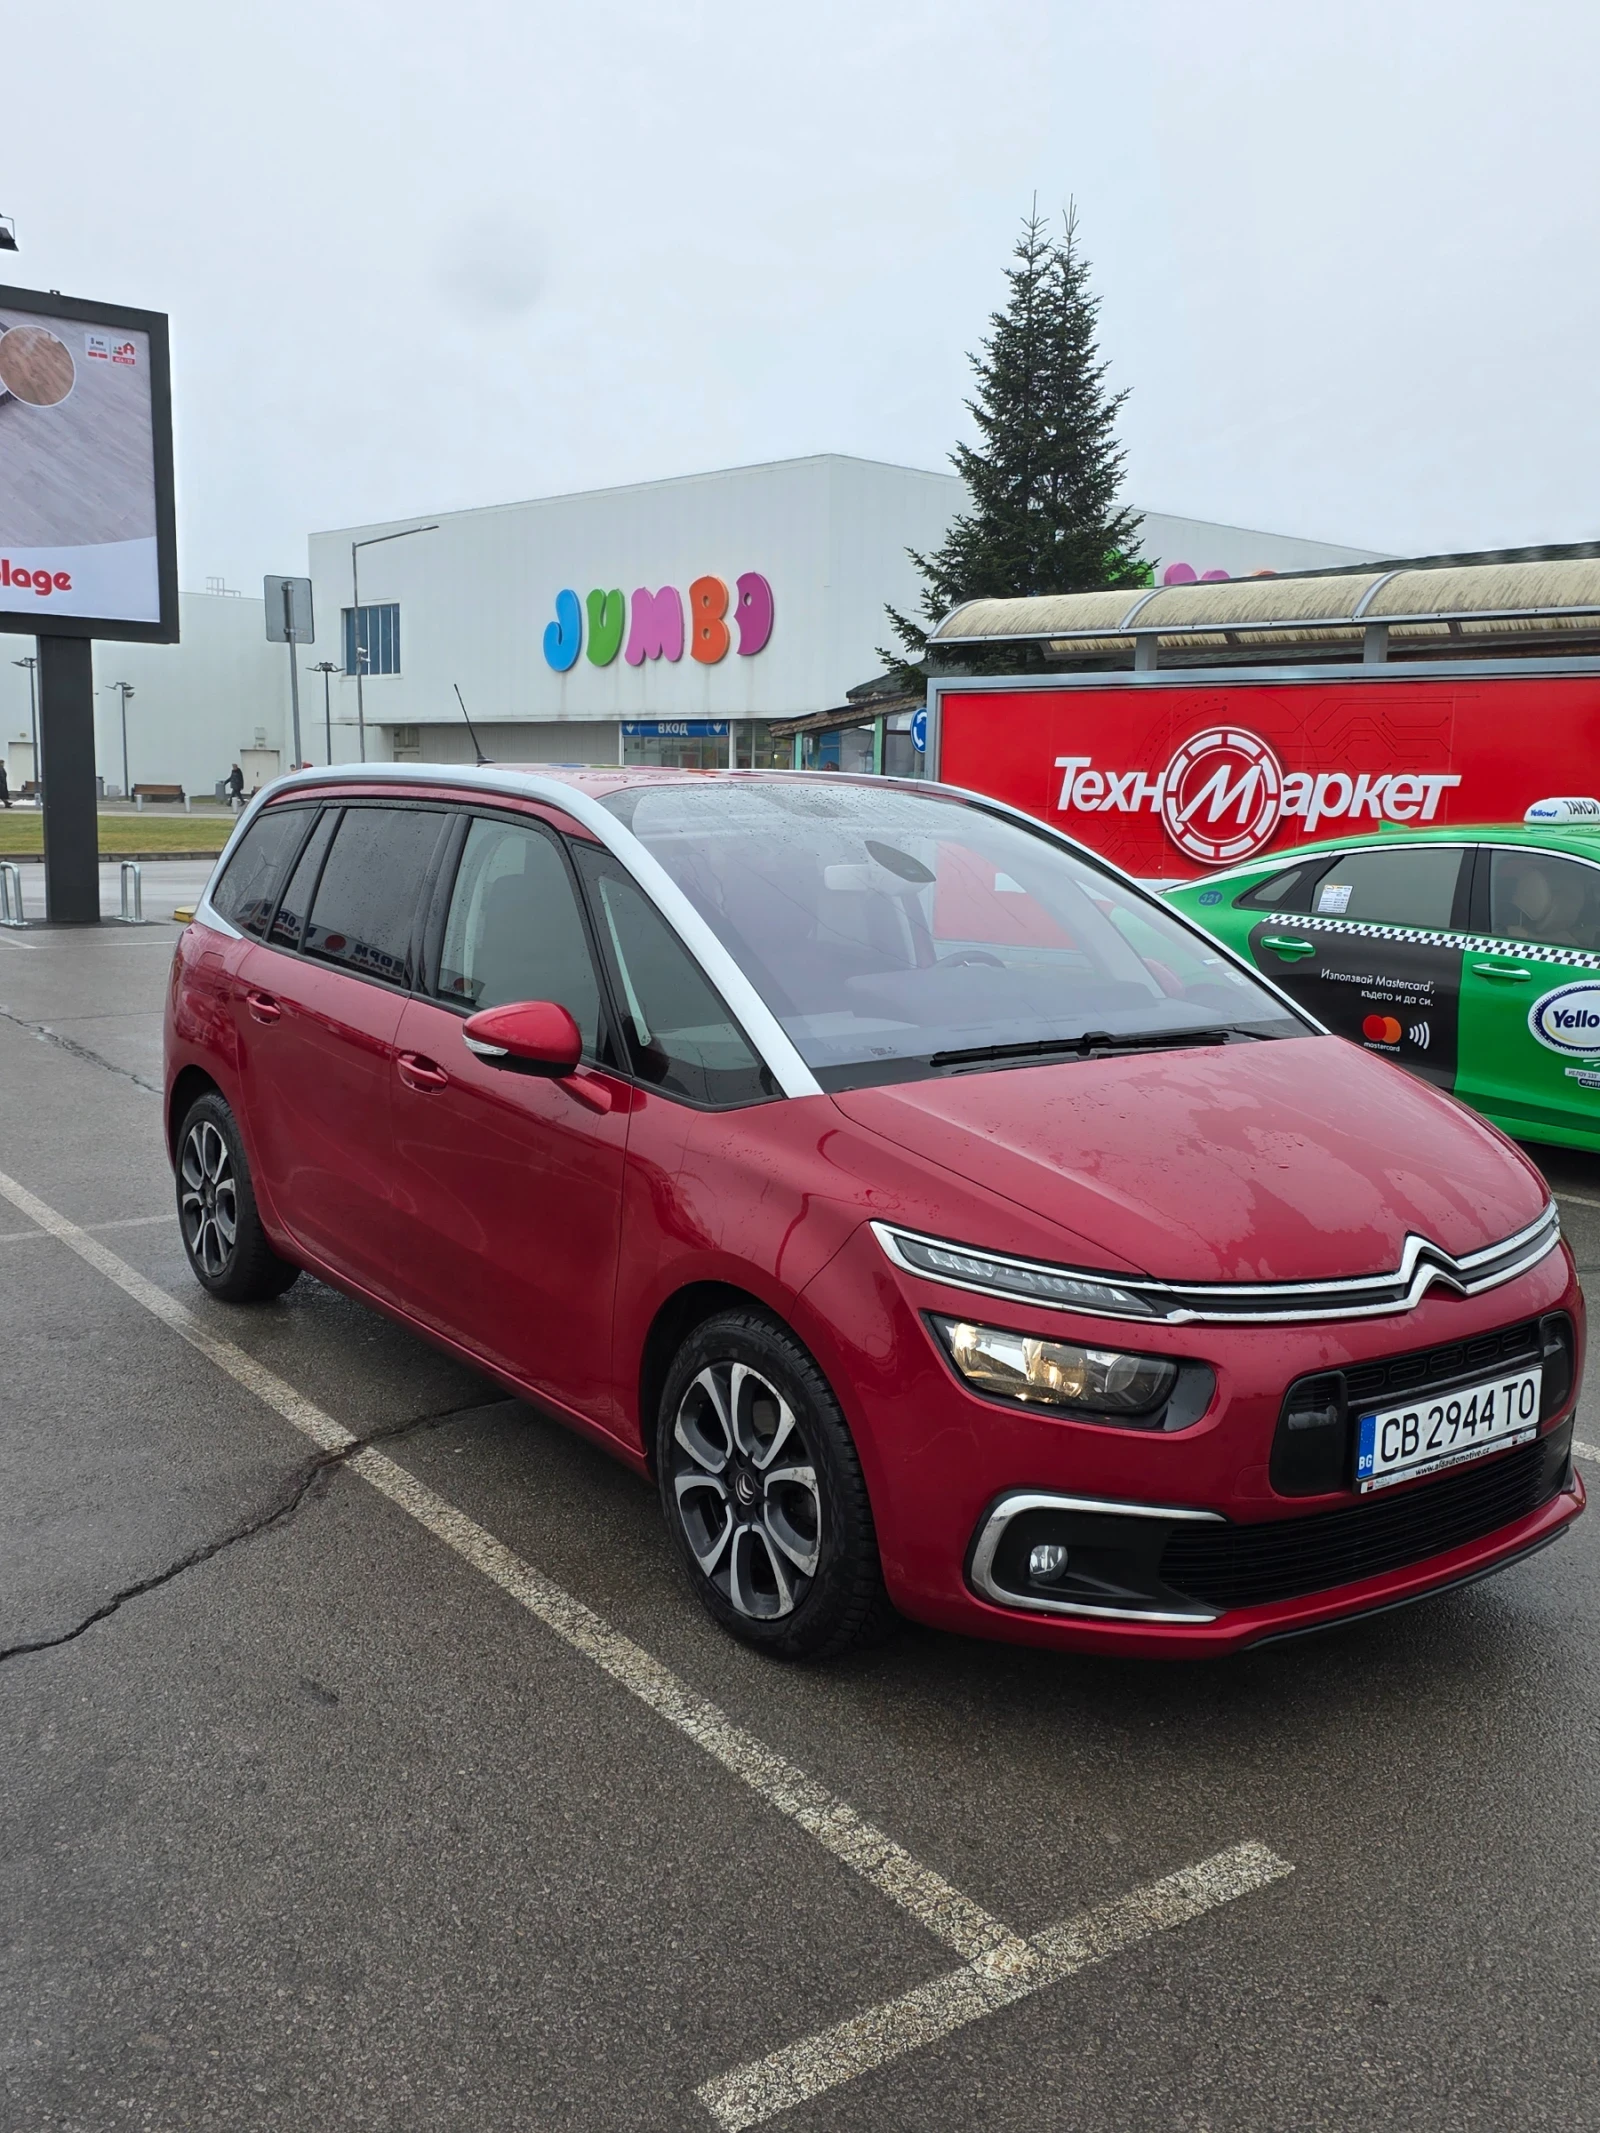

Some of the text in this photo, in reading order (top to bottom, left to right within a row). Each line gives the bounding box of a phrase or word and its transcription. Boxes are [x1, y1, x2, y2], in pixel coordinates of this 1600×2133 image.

[0, 559, 73, 596] lage
[543, 572, 774, 672] JUMBO
[658, 722, 688, 736] ВХОД
[1530, 809, 1558, 817] Yellow!
[1200, 893, 1221, 904] 321
[1321, 968, 1373, 985] Използвай
[1361, 990, 1434, 1007] където и да си.
[1363, 1042, 1400, 1052] mastercard
[1358, 1454, 1373, 1470] BG
[1415, 1446, 1490, 1476] www.aldautomotive.cz
